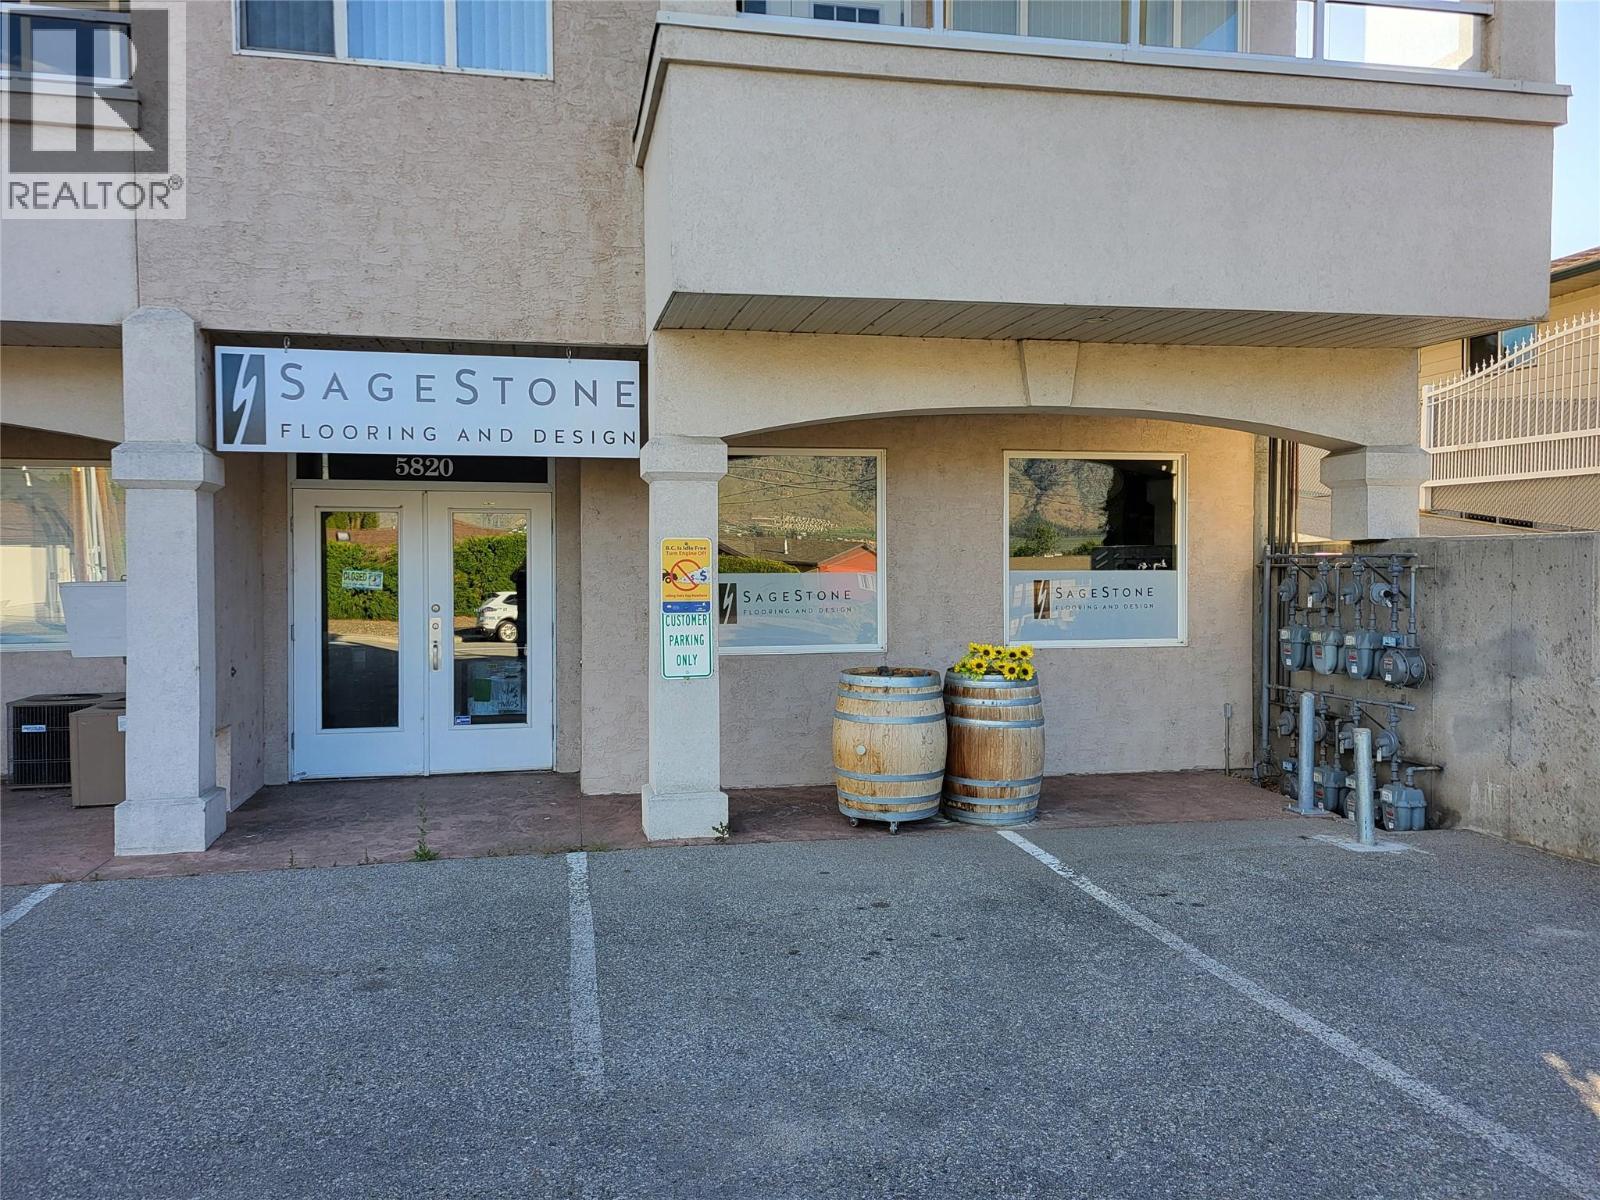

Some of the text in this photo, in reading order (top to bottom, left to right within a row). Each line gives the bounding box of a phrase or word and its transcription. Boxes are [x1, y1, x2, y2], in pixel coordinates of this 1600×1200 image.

[280, 423, 637, 445] FLOORING AND DESIGN
[395, 456, 454, 477] 5820
[743, 608, 790, 616] FLOORING
[665, 614, 708, 627] CUSTOMER
[669, 634, 705, 646] PARKING
[676, 654, 698, 667] ONLY
